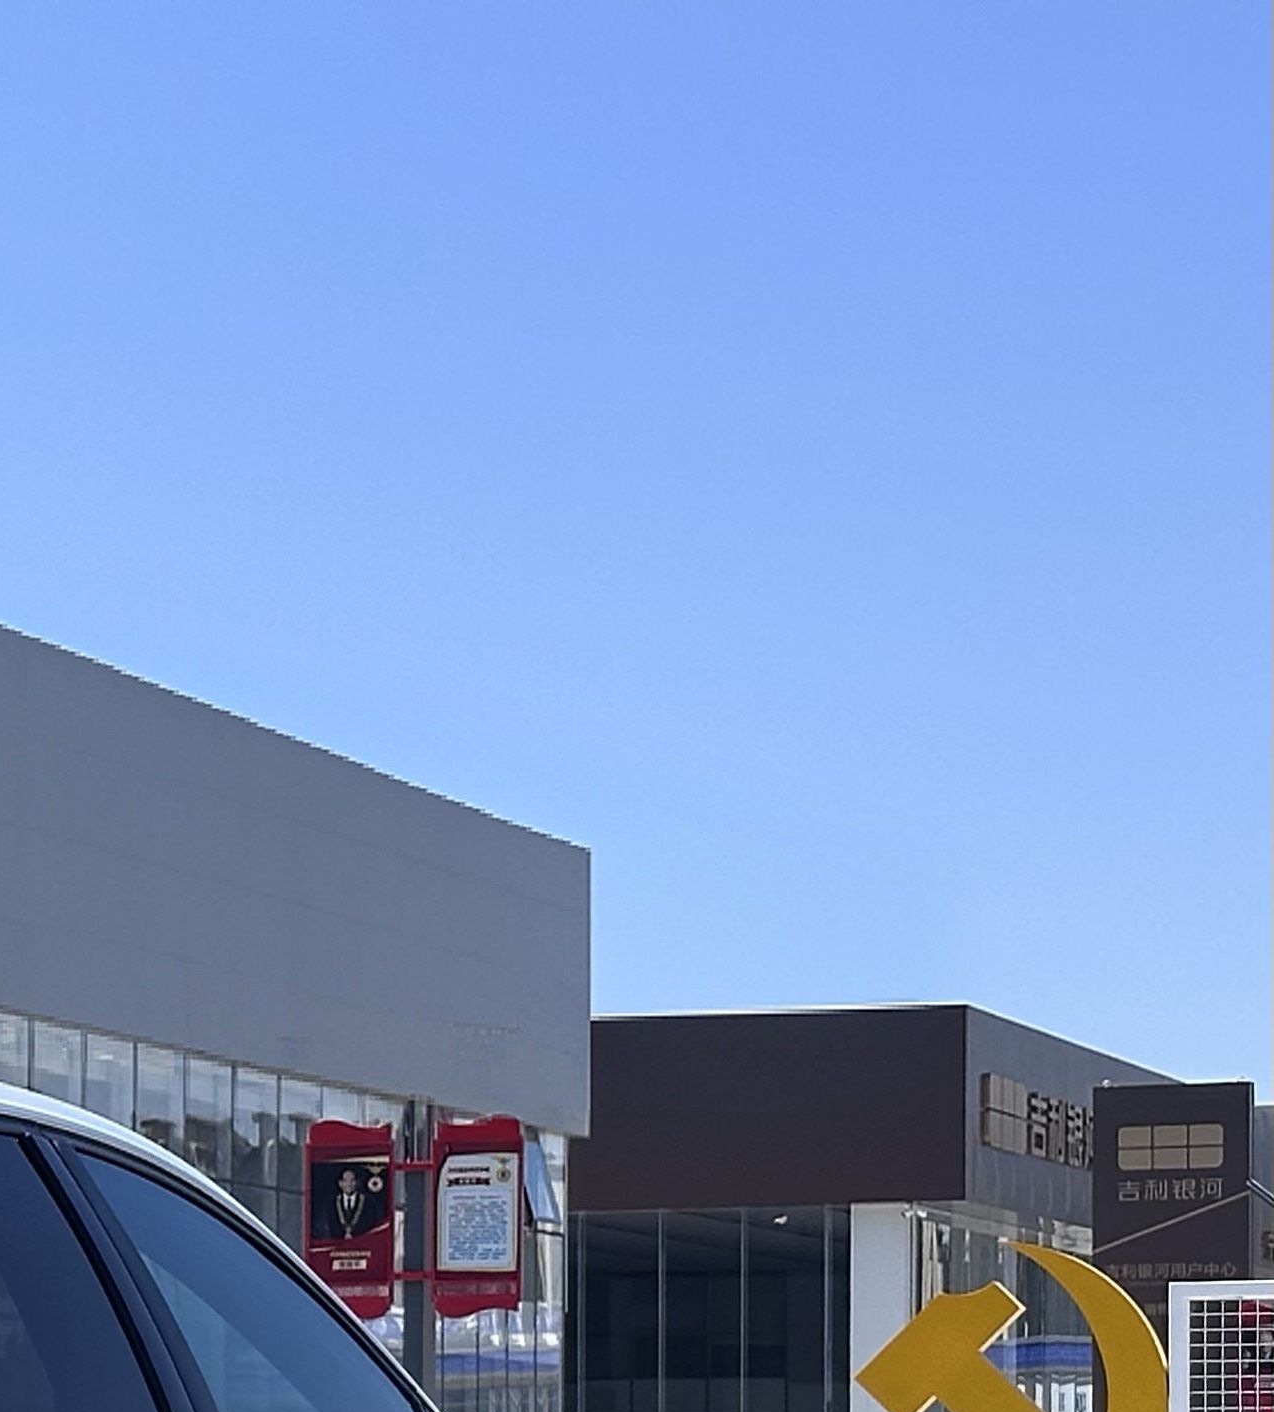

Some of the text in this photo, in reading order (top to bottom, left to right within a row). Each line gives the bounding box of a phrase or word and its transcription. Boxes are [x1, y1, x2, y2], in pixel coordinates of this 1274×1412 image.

[1029, 1093, 1092, 1168] 吉利银
[1117, 1178, 1223, 1201] 吉利银河
